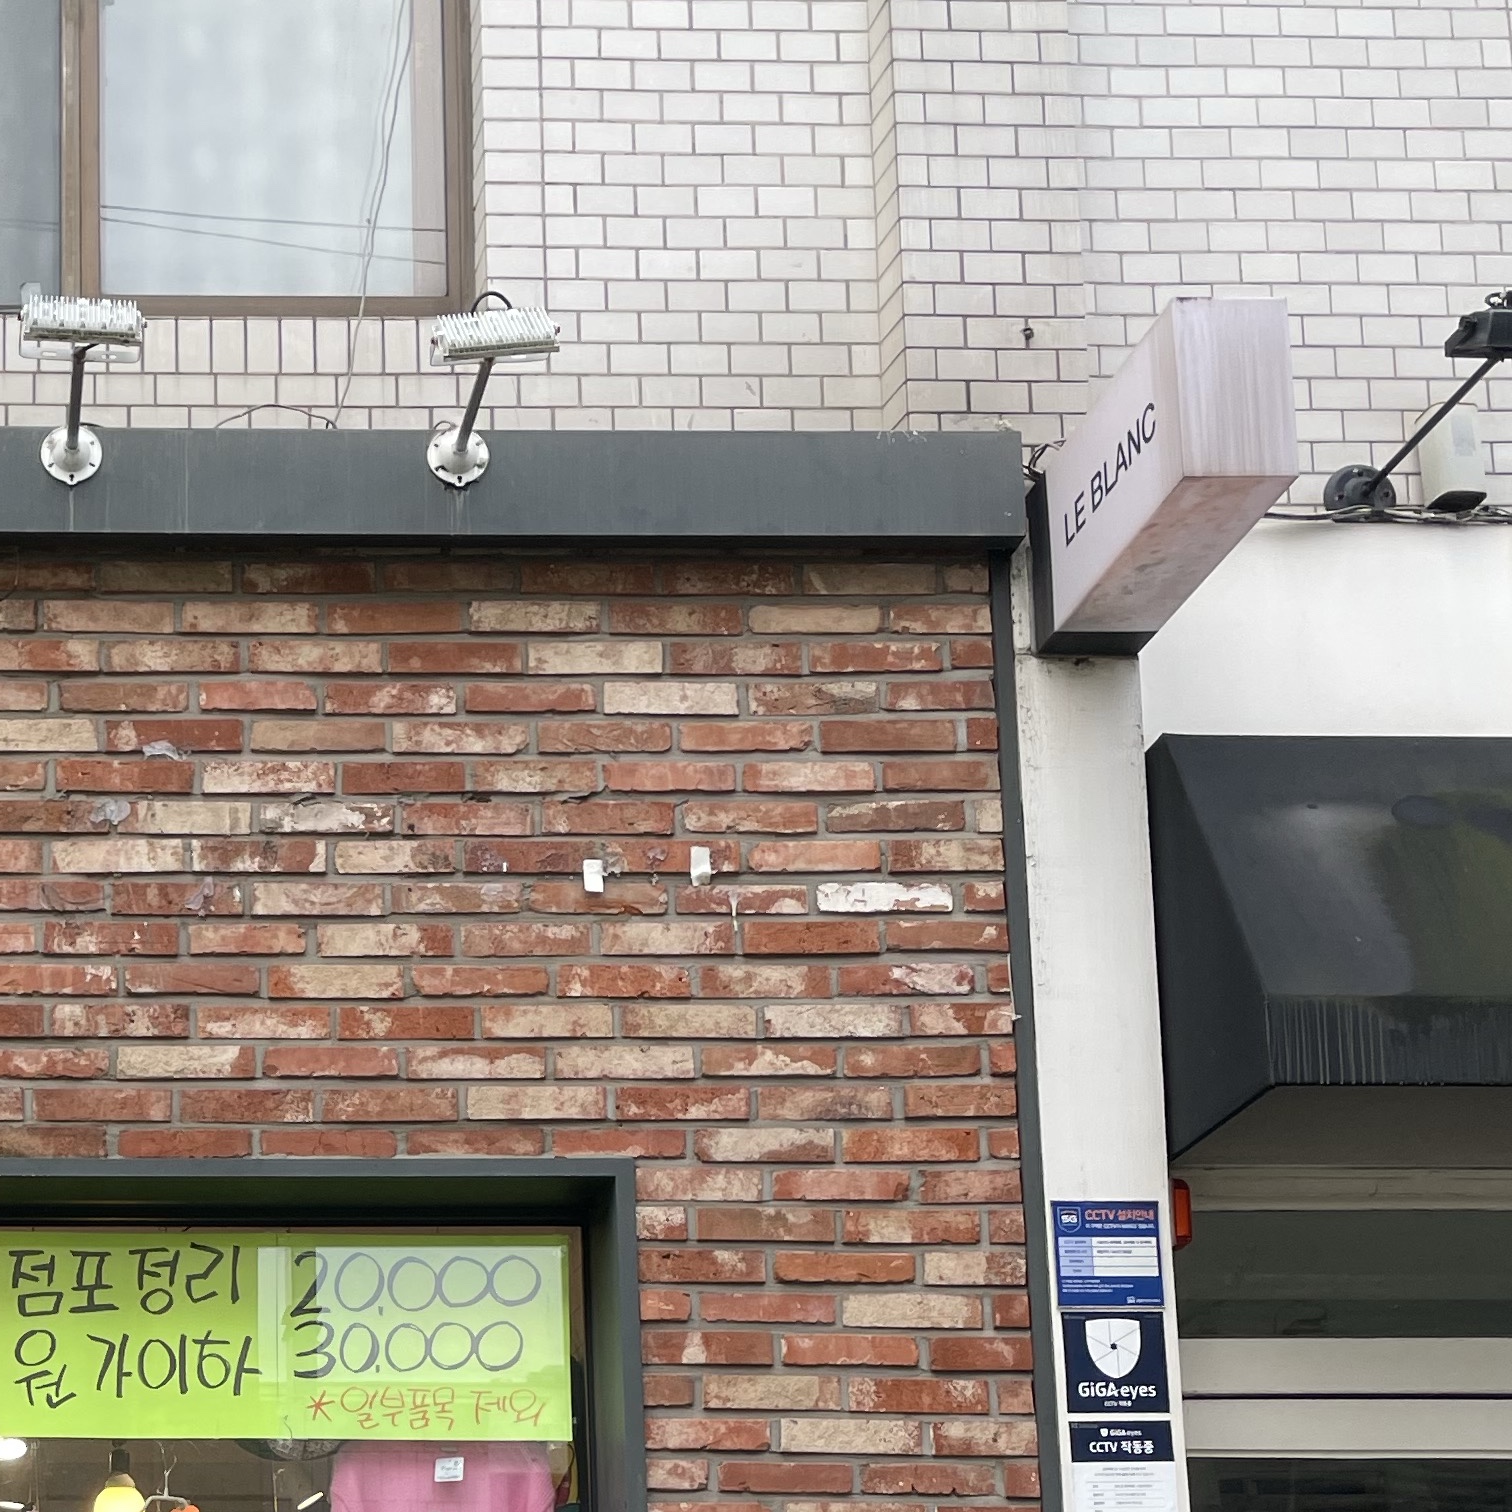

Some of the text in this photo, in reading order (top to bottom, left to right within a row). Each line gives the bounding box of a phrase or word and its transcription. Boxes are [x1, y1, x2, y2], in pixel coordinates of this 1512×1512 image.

[1063, 402, 1156, 548] LE BLANC
[1085, 1209, 1155, 1221] CCTV 설치안내
[9, 1242, 241, 1317] 점포정리
[470, 1388, 546, 1427] 제외
[1089, 1440, 1154, 1454] CCTV 작동중
